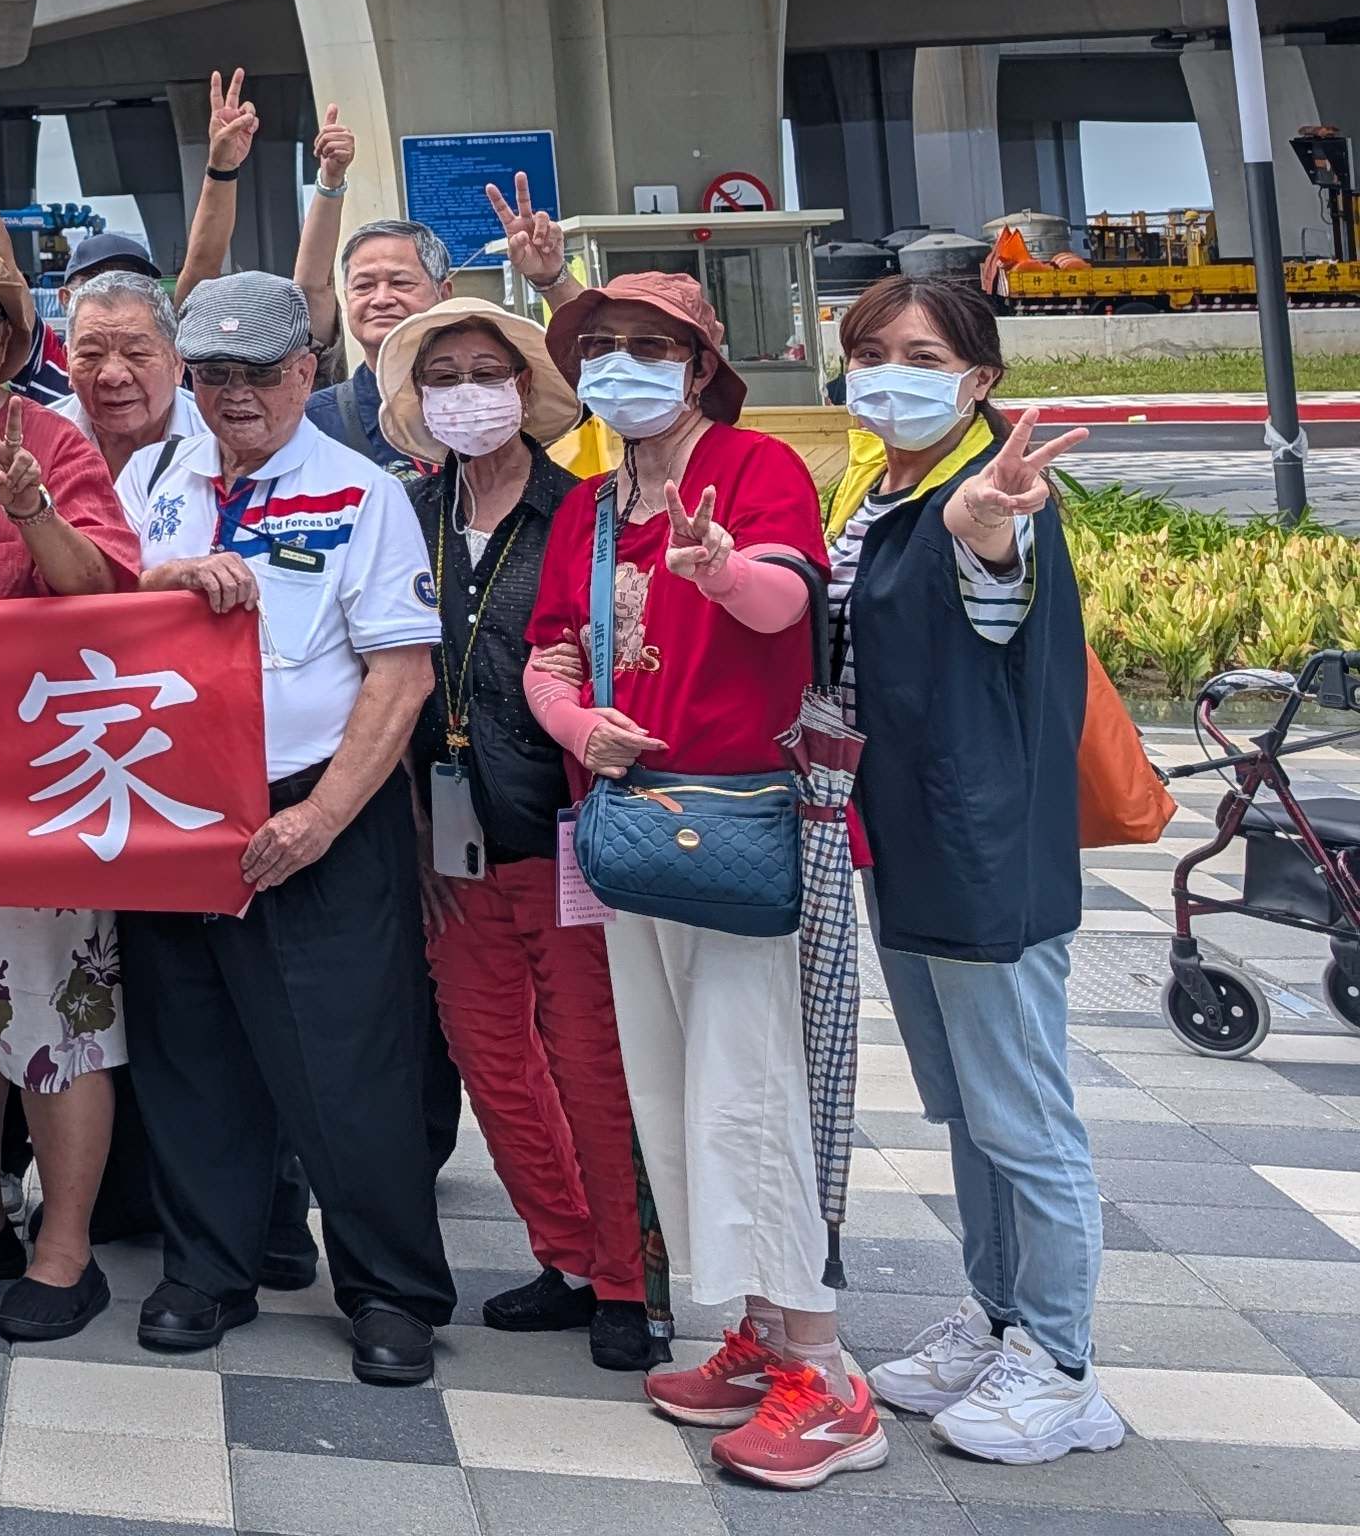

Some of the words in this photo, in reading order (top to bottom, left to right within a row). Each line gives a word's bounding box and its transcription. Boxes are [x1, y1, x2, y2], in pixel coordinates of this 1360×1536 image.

[285, 518, 323, 529] Forces
[597, 511, 608, 563] JIELSHI
[595, 621, 604, 679] JIELSHI
